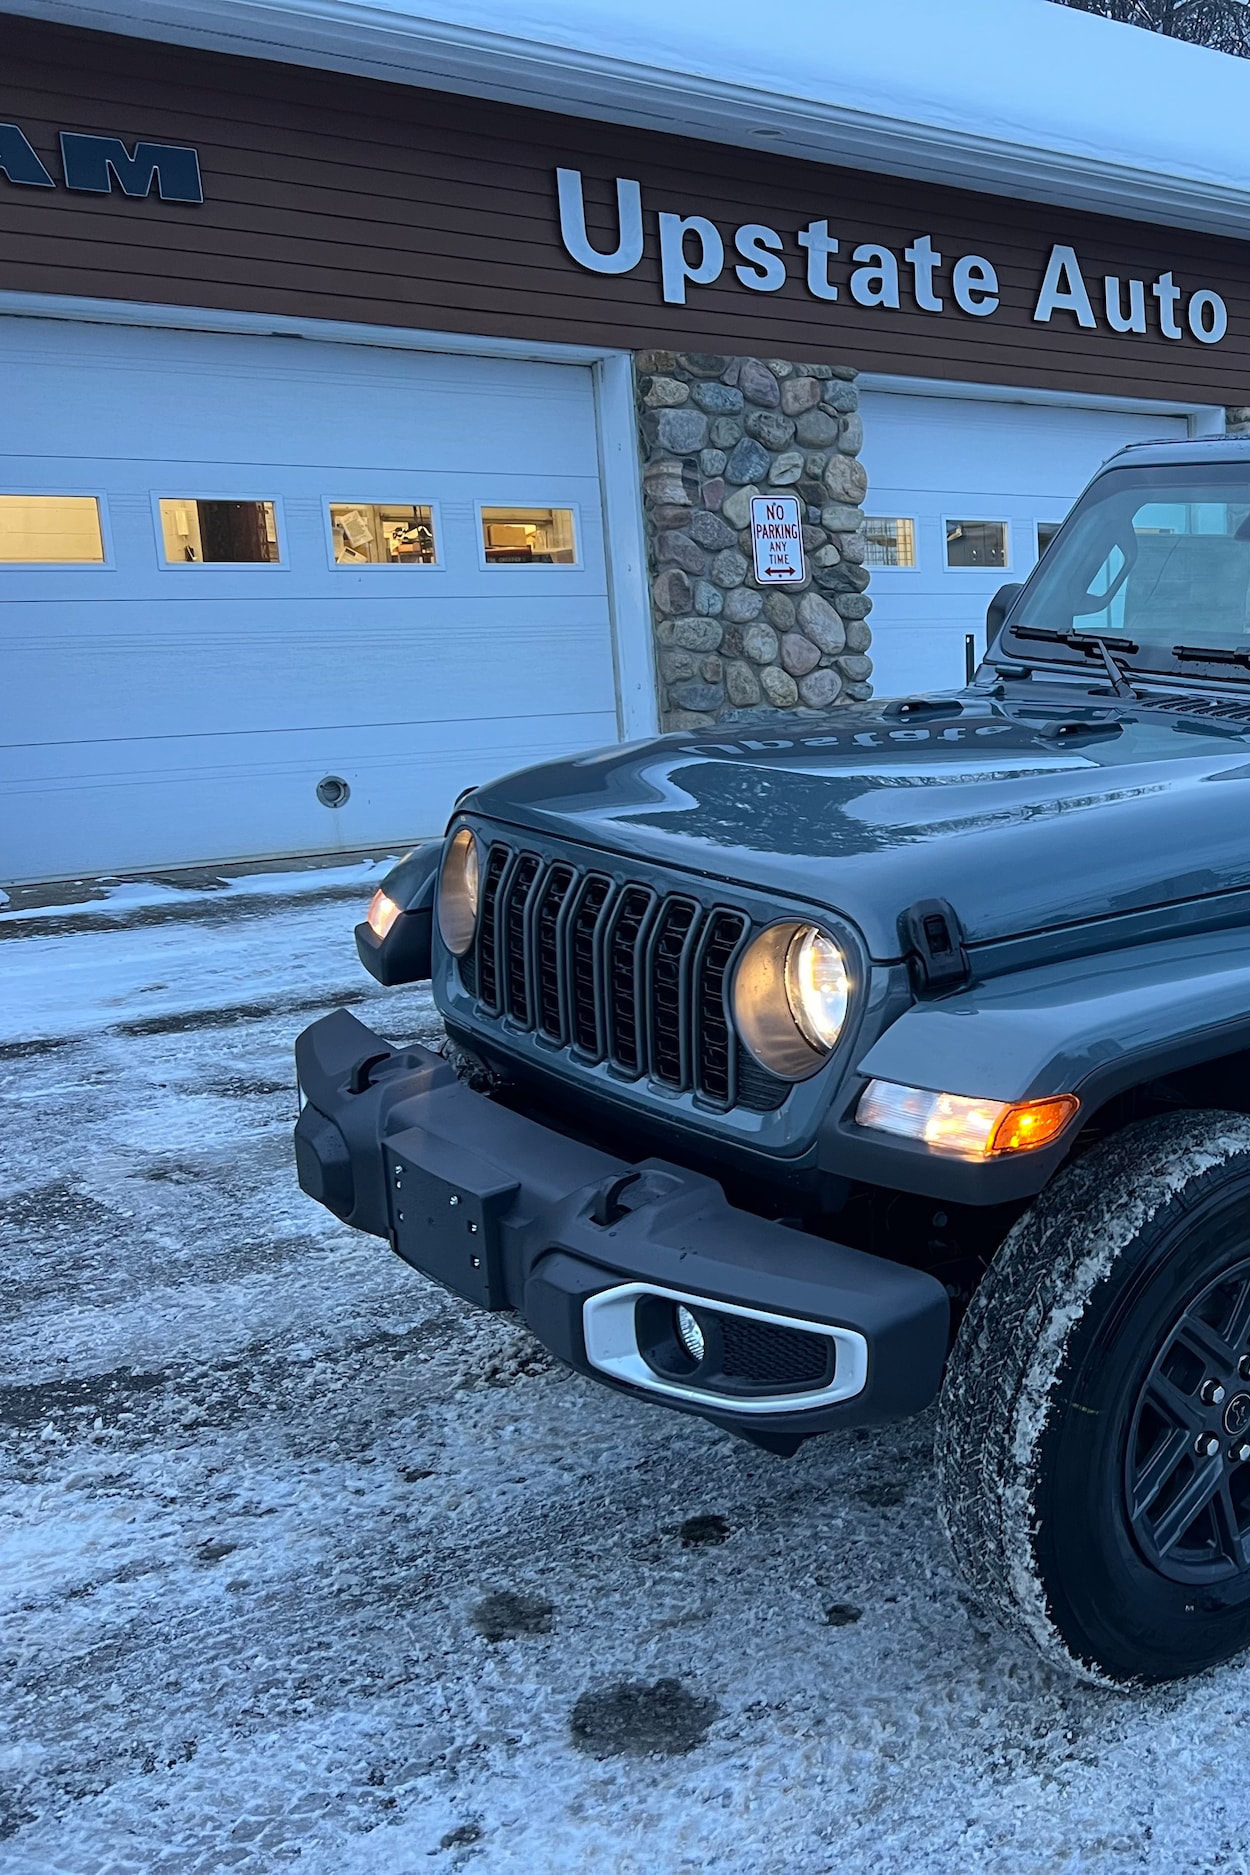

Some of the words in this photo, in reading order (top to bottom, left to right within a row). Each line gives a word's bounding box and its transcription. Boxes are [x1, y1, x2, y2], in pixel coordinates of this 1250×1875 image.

[556, 167, 1000, 317] Upstate
[1033, 243, 1228, 345] Auto
[766, 504, 784, 520] NO
[756, 523, 798, 539] PARKING
[769, 541, 787, 552] ANY
[769, 553, 790, 565] TIME
